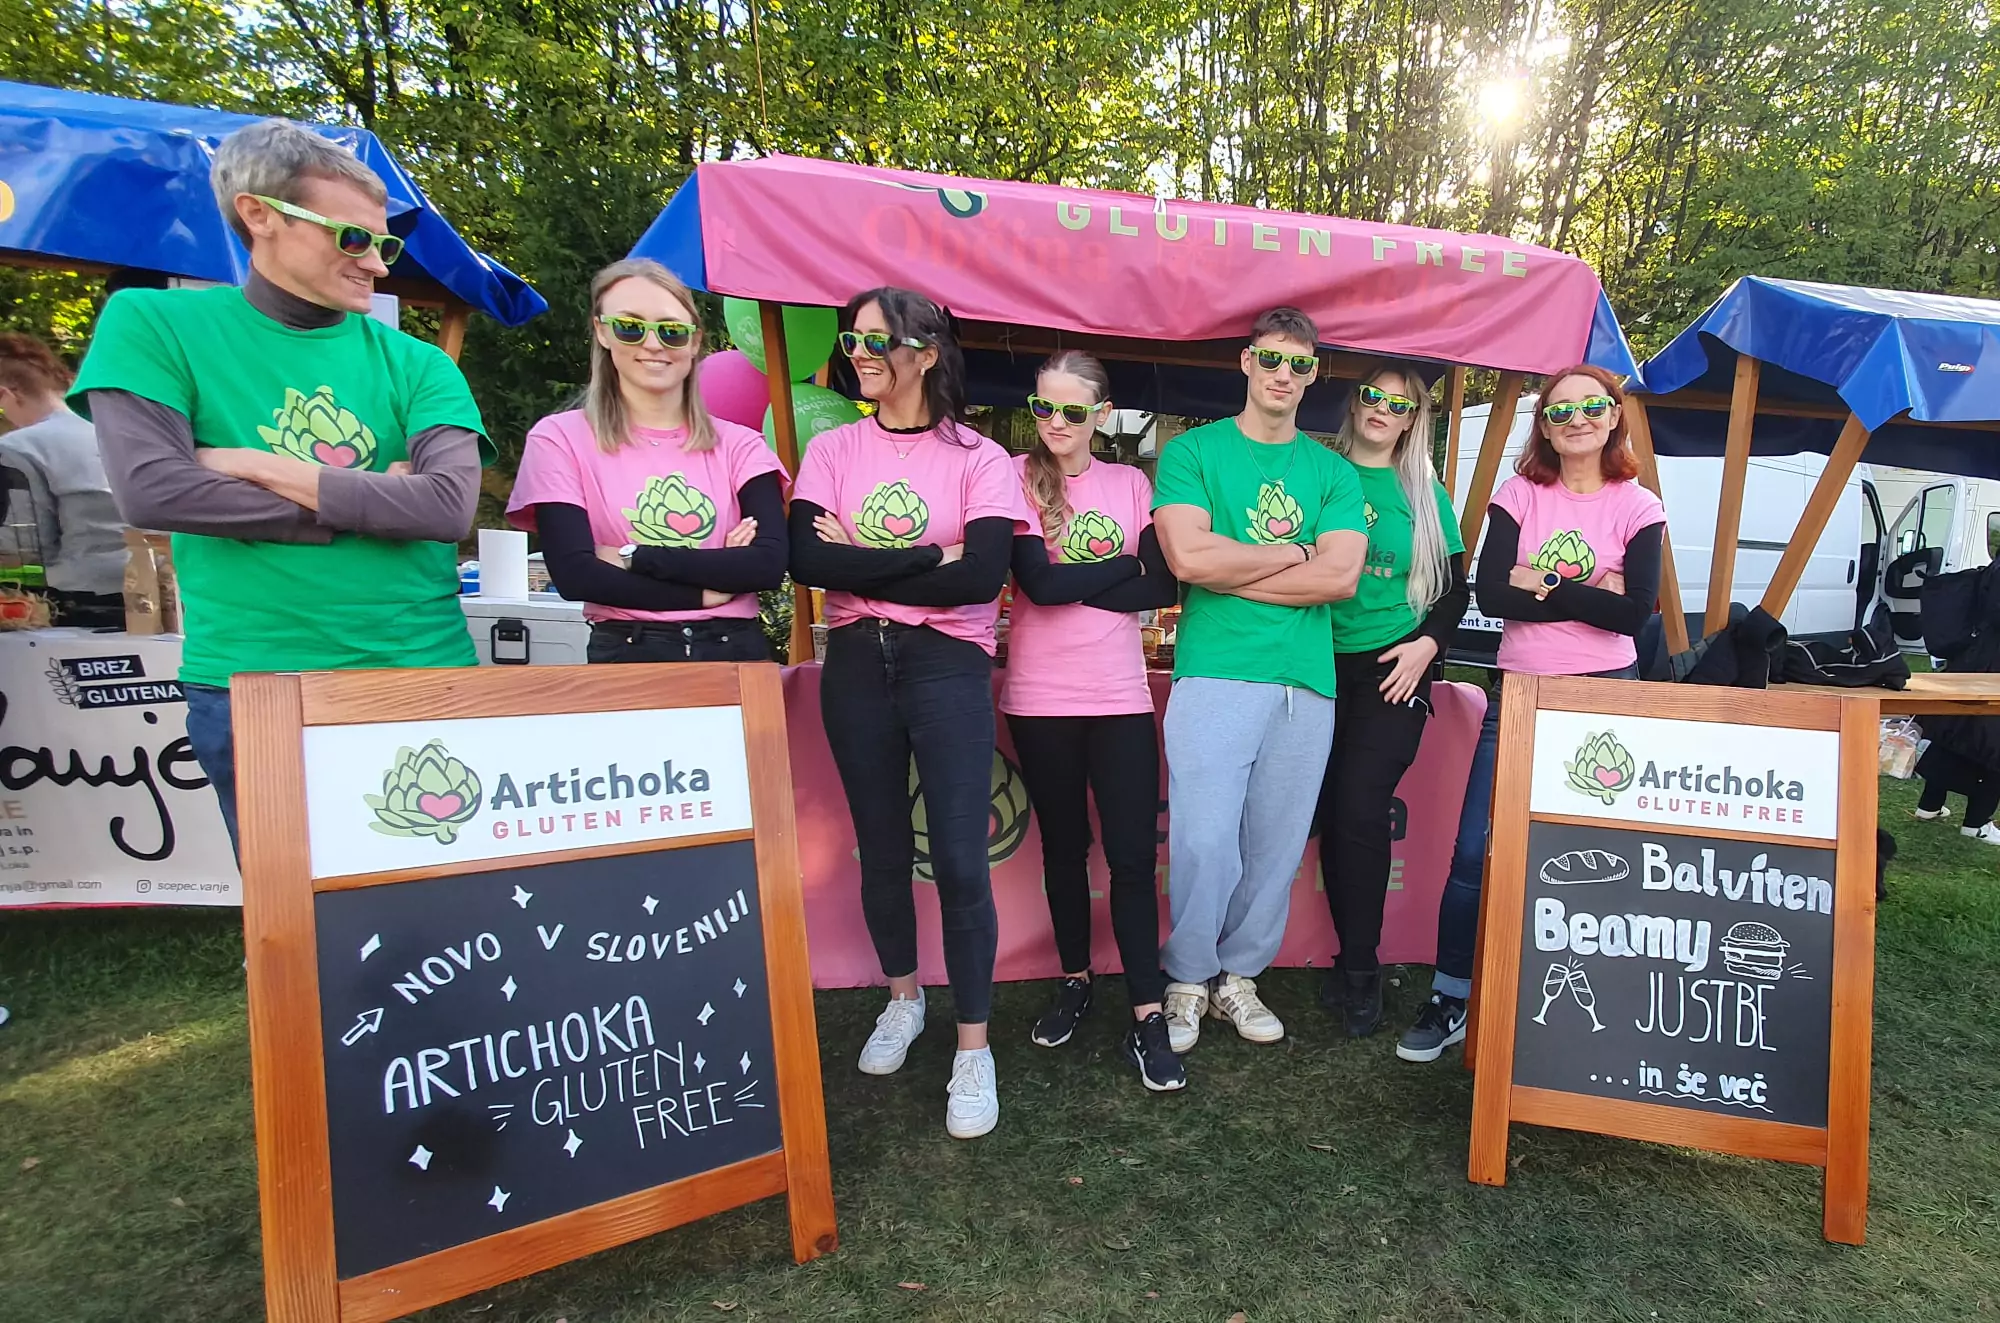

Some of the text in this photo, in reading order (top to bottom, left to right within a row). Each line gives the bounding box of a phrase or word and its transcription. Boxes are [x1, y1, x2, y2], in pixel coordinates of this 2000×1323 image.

[78, 659, 134, 677] BREZ
[87, 683, 184, 704] GLUTENA
[491, 759, 711, 811] Artichoka
[1639, 760, 1804, 801] Artichoka
[492, 800, 714, 840] GLUTEN FREE
[1637, 796, 1804, 824] GLUTEN FREE
[1642, 842, 1833, 914] Balviten
[392, 889, 750, 1004] NOVO V SLOVENIJI
[1534, 897, 1711, 972] Beamy
[384, 995, 655, 1114] ARTICHOKA
[531, 1041, 686, 1126] GLUTEN
[1676, 1063, 1709, 1095] še
[1718, 1073, 1769, 1104] več
[632, 1081, 734, 1149] FREE
